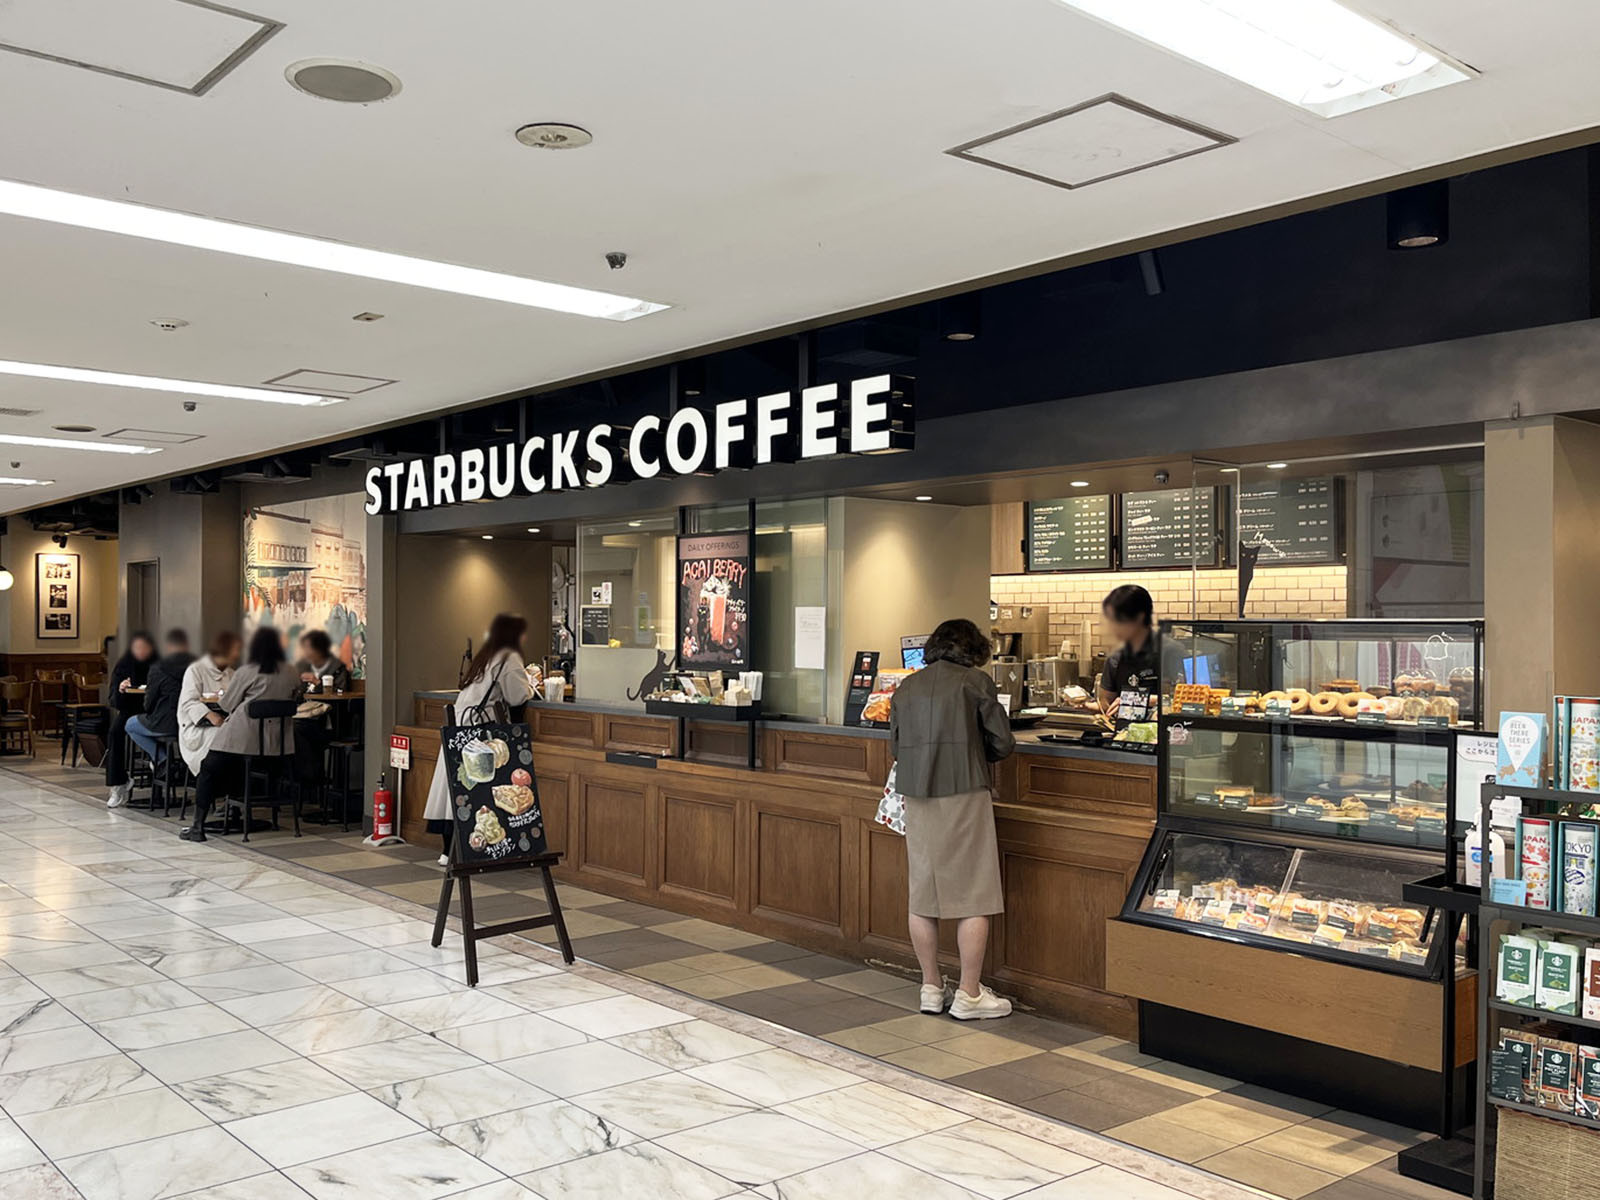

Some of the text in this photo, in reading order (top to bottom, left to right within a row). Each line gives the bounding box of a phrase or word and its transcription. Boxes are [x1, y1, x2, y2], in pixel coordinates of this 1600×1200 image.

[365, 374, 890, 515] STARBUCKS COFFEE
[688, 541, 740, 552] DAILY OFFERINGS
[713, 559, 747, 589] BERRY
